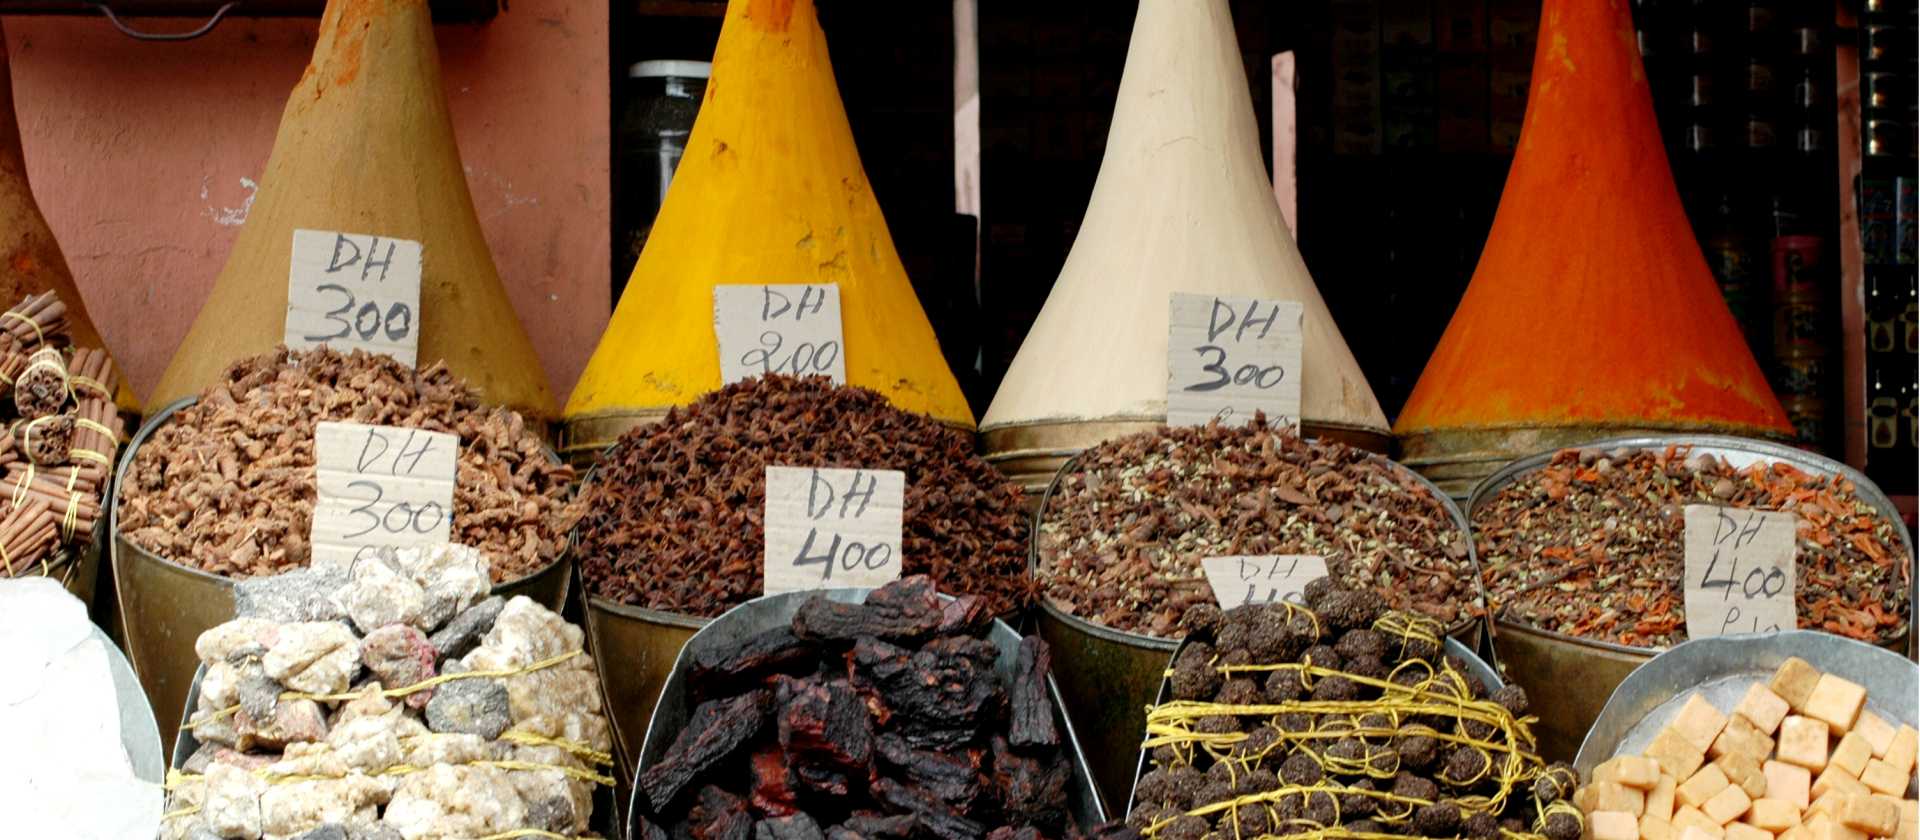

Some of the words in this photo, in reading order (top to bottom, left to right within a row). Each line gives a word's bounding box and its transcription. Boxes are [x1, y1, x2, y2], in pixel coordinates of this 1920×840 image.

[326, 234, 396, 282] DH
[304, 284, 411, 341] 300
[762, 285, 825, 321] DH
[1208, 297, 1279, 342] DH
[741, 331, 838, 374] 200
[1184, 345, 1284, 391] 300
[357, 428, 437, 475] DH
[343, 481, 443, 539] 300
[808, 469, 876, 520] DH
[1714, 507, 1766, 550] DH
[792, 528, 890, 581] 400
[1237, 556, 1298, 581] DH
[1701, 549, 1785, 602] 400
